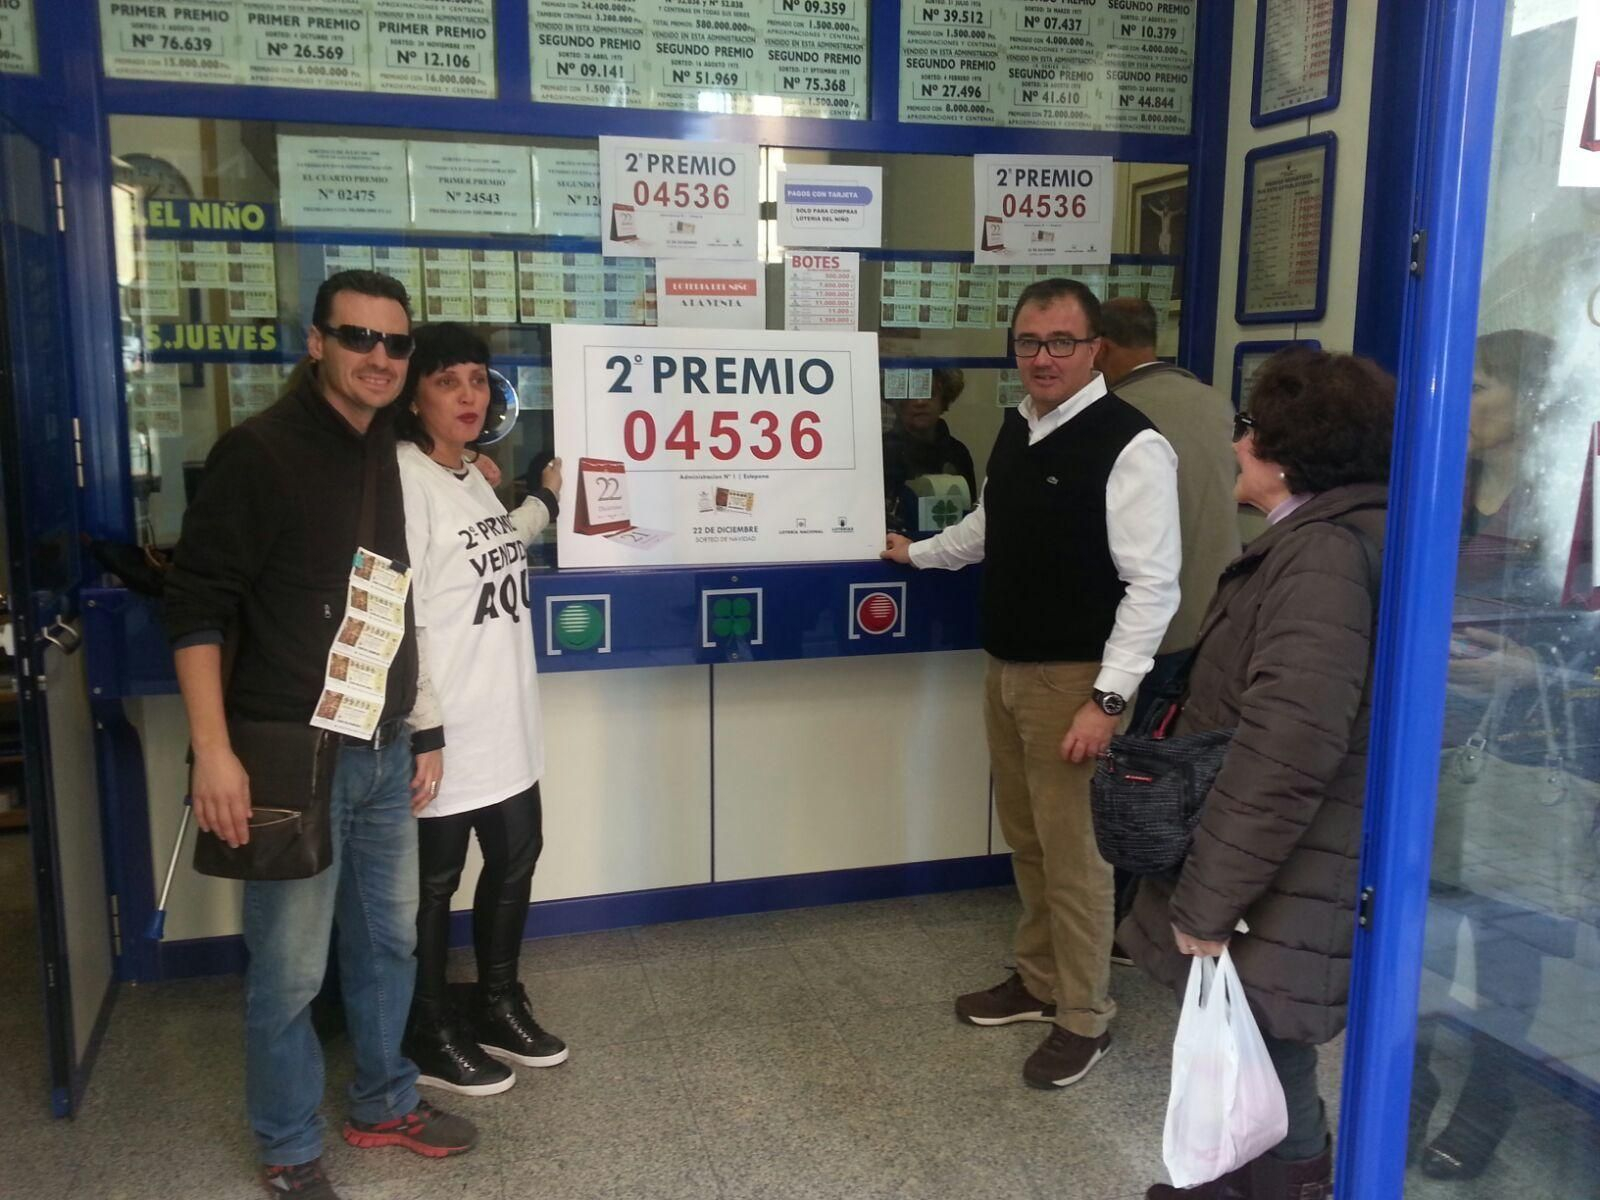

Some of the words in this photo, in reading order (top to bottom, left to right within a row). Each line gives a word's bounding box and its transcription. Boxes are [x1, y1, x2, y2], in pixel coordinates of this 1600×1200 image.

[110, 3, 167, 18] PRIMER
[174, 8, 229, 22] PREMIO
[782, 0, 800, 11] Nº
[804, 0, 846, 15] 09.359
[1108, 0, 1153, 12] SEGUNDO
[1157, 3, 1190, 15] PREMIO
[248, 13, 300, 27] PRIMER
[308, 16, 360, 31] PREMIO
[923, 8, 939, 21] Nº
[944, 9, 983, 24] 39.512
[1024, 15, 1040, 28] Nº
[1044, 16, 1082, 31] 07.437
[378, 21, 429, 35] PRIMER
[436, 25, 486, 40] PREMIO
[809, 19, 850, 31] 1.500.000
[1121, 24, 1136, 36] Nº
[1142, 25, 1177, 40] 10.379
[947, 28, 986, 39] 1.500.000
[132, 33, 154, 48] Nº
[160, 35, 212, 51] 76.639
[539, 34, 595, 48] SEGUNDO
[600, 37, 641, 51] PREMIO
[267, 42, 288, 56] Nº
[294, 44, 343, 60] 26.569
[656, 42, 709, 56] SEGUNDO
[715, 46, 754, 59] PREMIO
[768, 49, 819, 62] SEGUNDO
[824, 53, 862, 65] PREMIO
[397, 50, 417, 64] Nº
[424, 52, 470, 68] 12.106
[906, 58, 955, 69] SEGUNDO
[961, 60, 996, 71] PREMIO
[557, 62, 575, 76] Nº
[581, 63, 623, 78] 09.141
[672, 70, 691, 83] Nº
[695, 71, 738, 86] 51.969
[1009, 68, 1055, 80] SEGUNDO
[1060, 70, 1094, 82] PREMIO
[1106, 70, 1151, 82] SEGUNDO
[1155, 72, 1188, 84] PREMIO
[783, 77, 800, 89] Nº
[805, 77, 846, 91] 75.368
[921, 84, 938, 96] Nº
[942, 85, 982, 98] 27.496
[1022, 90, 1039, 102] Nº
[1042, 91, 1080, 104] 41.610
[1120, 94, 1135, 106] Nº
[1138, 95, 1174, 109] 44.844
[648, 153, 736, 176] PREMIO
[354, 176, 389, 184] PREMIO
[439, 176, 472, 185] PRIMER
[473, 178, 506, 186] PREMIO
[1015, 169, 1093, 187] PREMIO
[337, 189, 376, 202] 02475
[465, 191, 500, 204] 24543
[634, 180, 730, 209] 04536
[1002, 193, 1087, 218] 04536
[189, 202, 265, 230] NIÑO
[791, 255, 840, 269] BOTES
[146, 324, 277, 351] S.JUEVES
[605, 354, 643, 393] 2º
[653, 356, 834, 395] PREMIO
[623, 409, 823, 461] 04536
[596, 477, 622, 501] 22
[692, 527, 703, 535] 22
[704, 526, 714, 534] DE
[717, 526, 759, 534] DICIEMBRE
